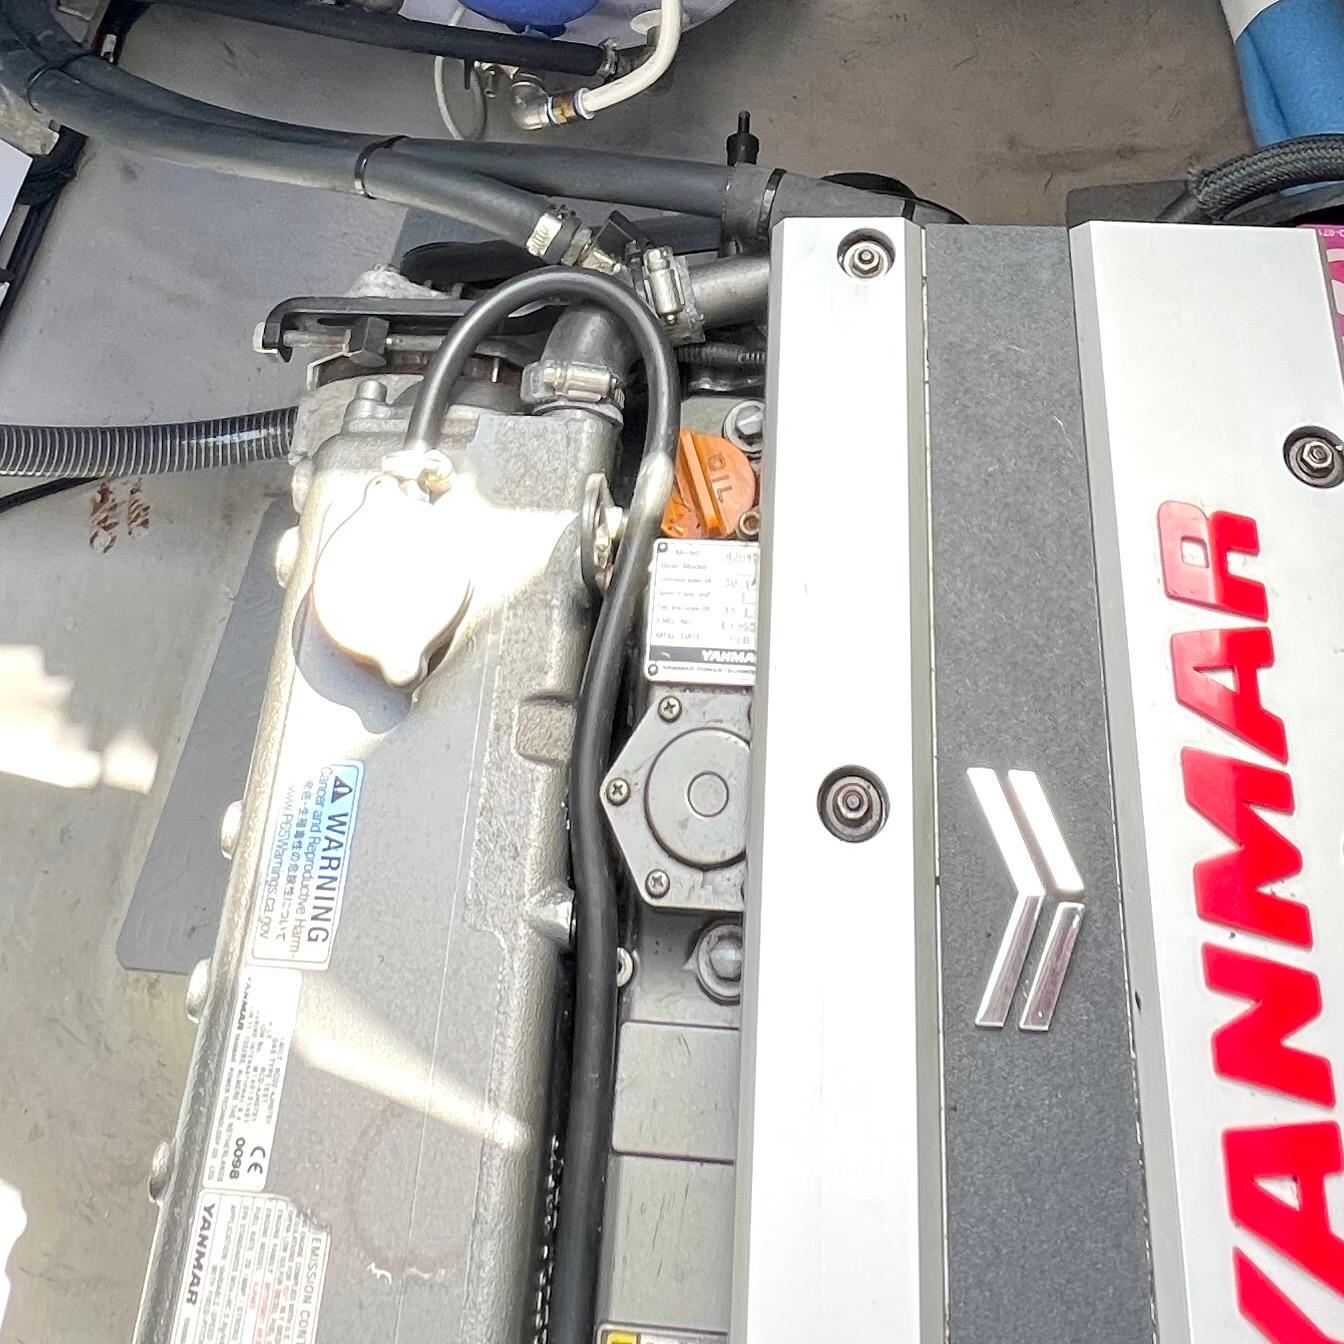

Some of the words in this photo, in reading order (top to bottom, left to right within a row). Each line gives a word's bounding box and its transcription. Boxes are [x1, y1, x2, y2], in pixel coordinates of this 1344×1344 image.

[707, 452, 733, 504] OIL
[316, 766, 333, 806] Cancer
[310, 810, 324, 834] and
[296, 835, 321, 915] Reproductive
[307, 812, 349, 943] WARNING
[229, 1136, 246, 1180] 0098
[186, 1202, 216, 1306] YANMAR
[302, 1237, 322, 1305] EMISSION
